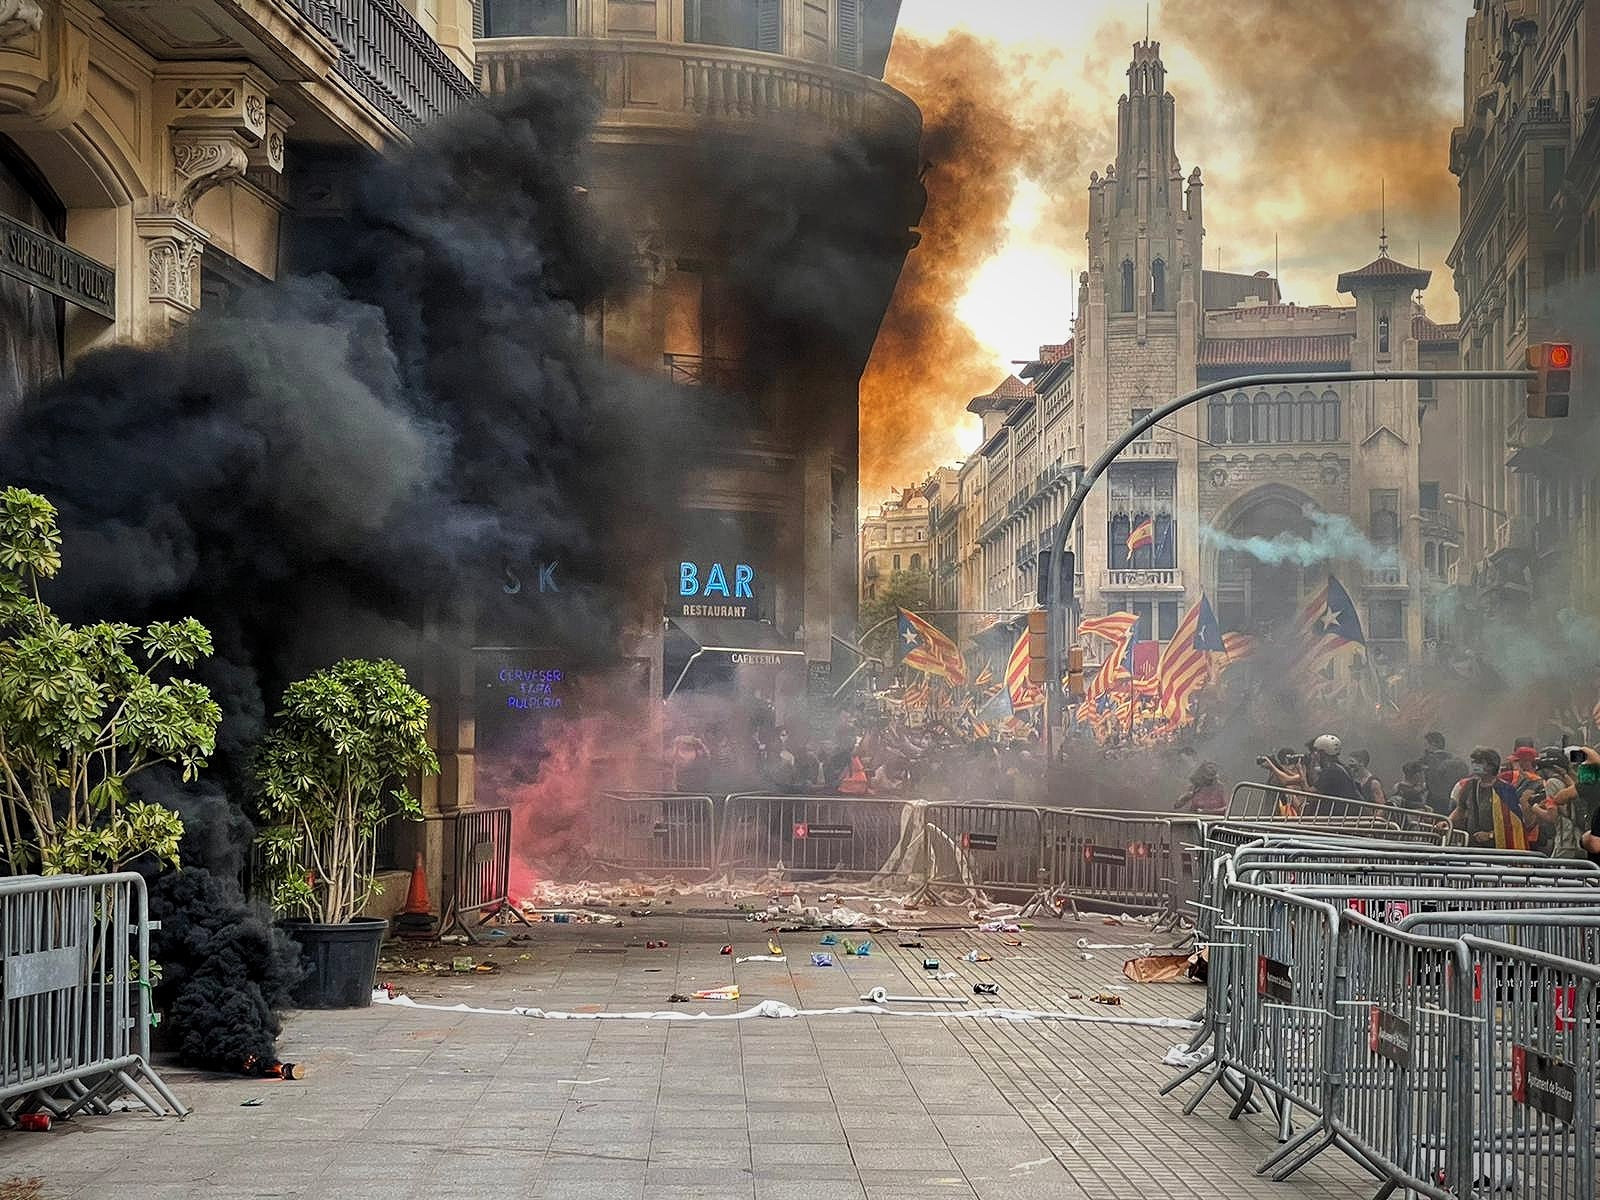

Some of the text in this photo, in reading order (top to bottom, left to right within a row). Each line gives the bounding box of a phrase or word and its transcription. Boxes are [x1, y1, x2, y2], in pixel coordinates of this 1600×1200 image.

[9, 231, 58, 280] SUPERIOR
[62, 254, 74, 289] DE
[680, 561, 754, 598] BAR
[683, 604, 747, 617] RESTAURANT
[731, 653, 782, 665] CAFETERIA
